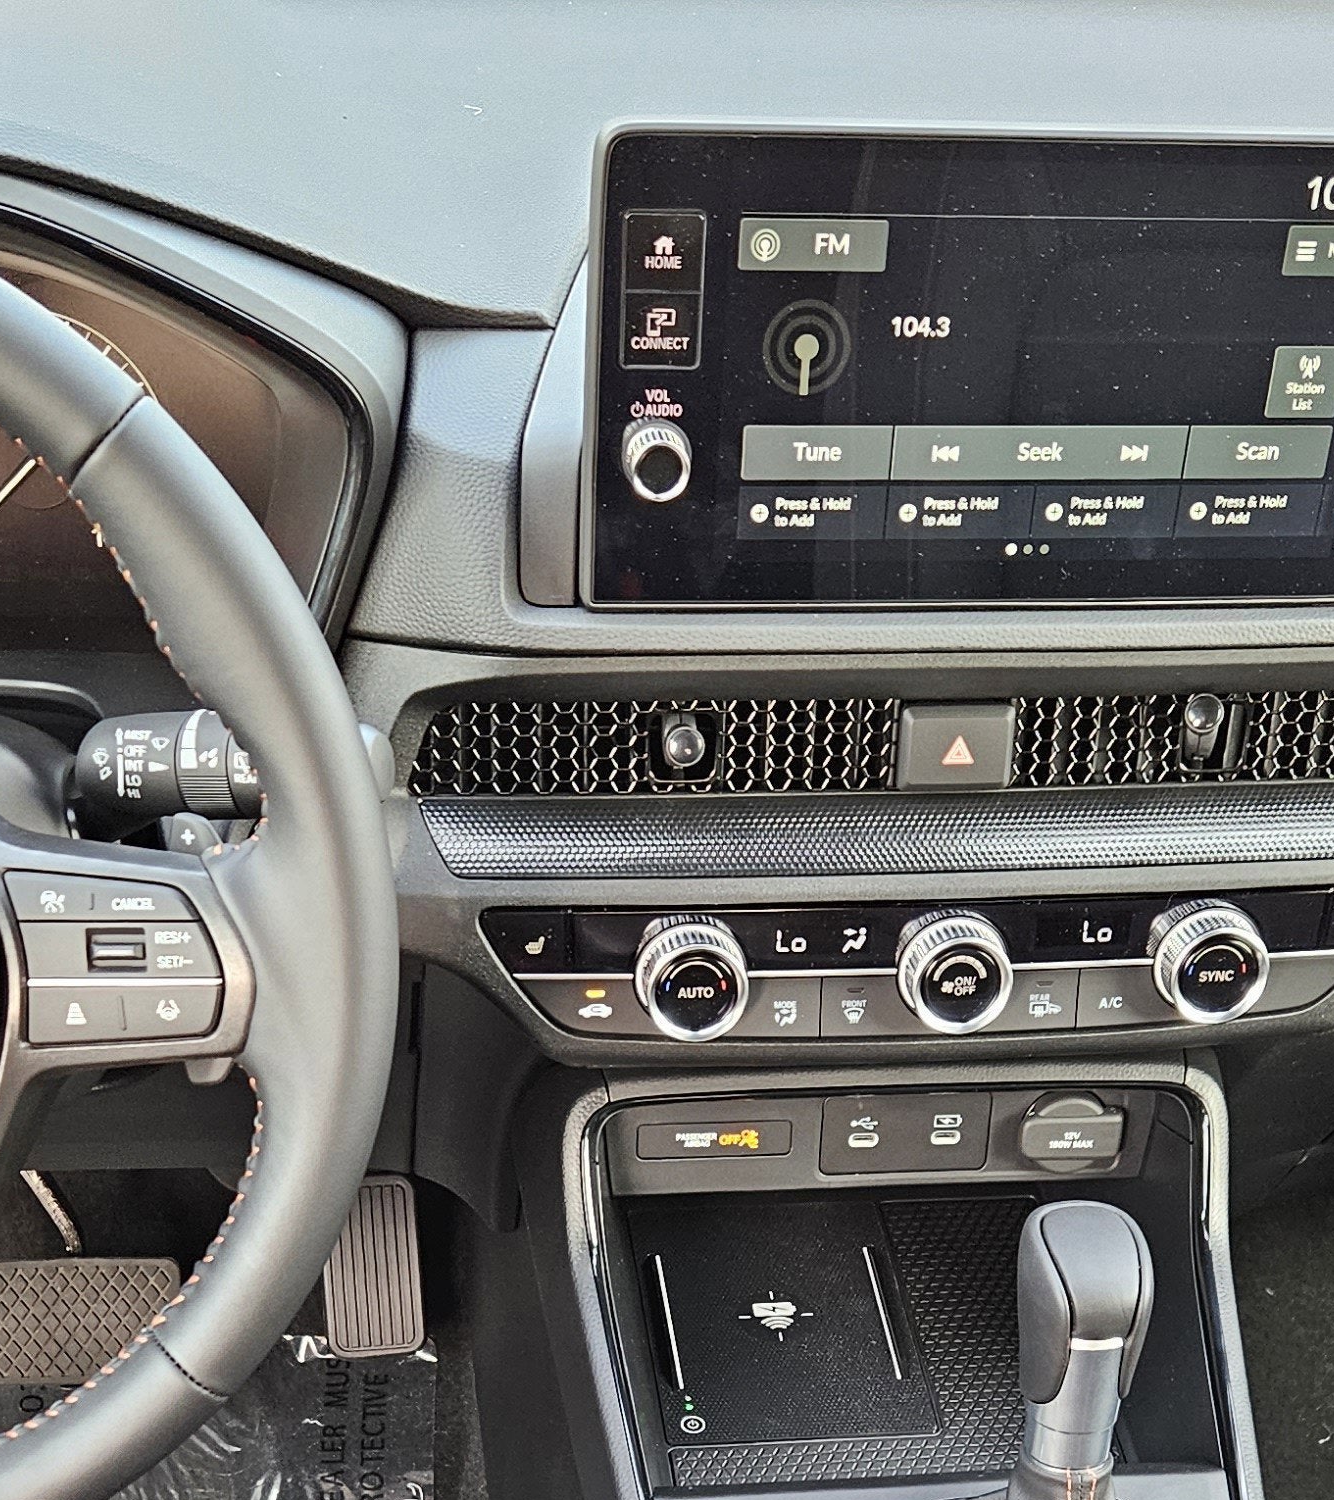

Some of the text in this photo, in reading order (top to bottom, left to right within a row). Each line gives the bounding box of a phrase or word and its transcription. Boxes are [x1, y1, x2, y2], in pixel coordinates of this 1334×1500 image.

[814, 232, 851, 255] FM
[644, 255, 683, 270] HOME
[890, 316, 951, 339] 104.3
[630, 336, 690, 350] CONNECT
[1285, 382, 1326, 394] Station
[644, 389, 671, 402] VOL
[644, 404, 683, 418] AUDIO
[1291, 398, 1314, 411] List
[792, 441, 843, 462] Tune
[1016, 441, 1064, 462] Seek
[1235, 441, 1280, 461] Scan
[775, 497, 852, 511] Press & Hold
[923, 497, 999, 511] Press & Hold
[1070, 496, 1145, 510] Press & Hold
[1214, 495, 1288, 509] Press & Hold
[774, 514, 815, 527] to Add
[922, 514, 962, 527] to Add
[1068, 513, 1107, 526] to Add
[1211, 512, 1251, 525] to Add
[124, 744, 147, 757] OFF
[124, 759, 145, 772] INT
[125, 774, 142, 787] LO
[126, 787, 142, 799] HI
[111, 897, 156, 911] CANCEL
[1198, 968, 1235, 984] SYNC
[677, 986, 715, 1000] AUTO
[954, 984, 976, 997] OFF
[841, 1000, 867, 1009] FRONT
[1029, 994, 1051, 1003] REAR
[1098, 996, 1123, 1009] A/C
[774, 1001, 798, 1011] MODE
[718, 1133, 742, 1146] OFF
